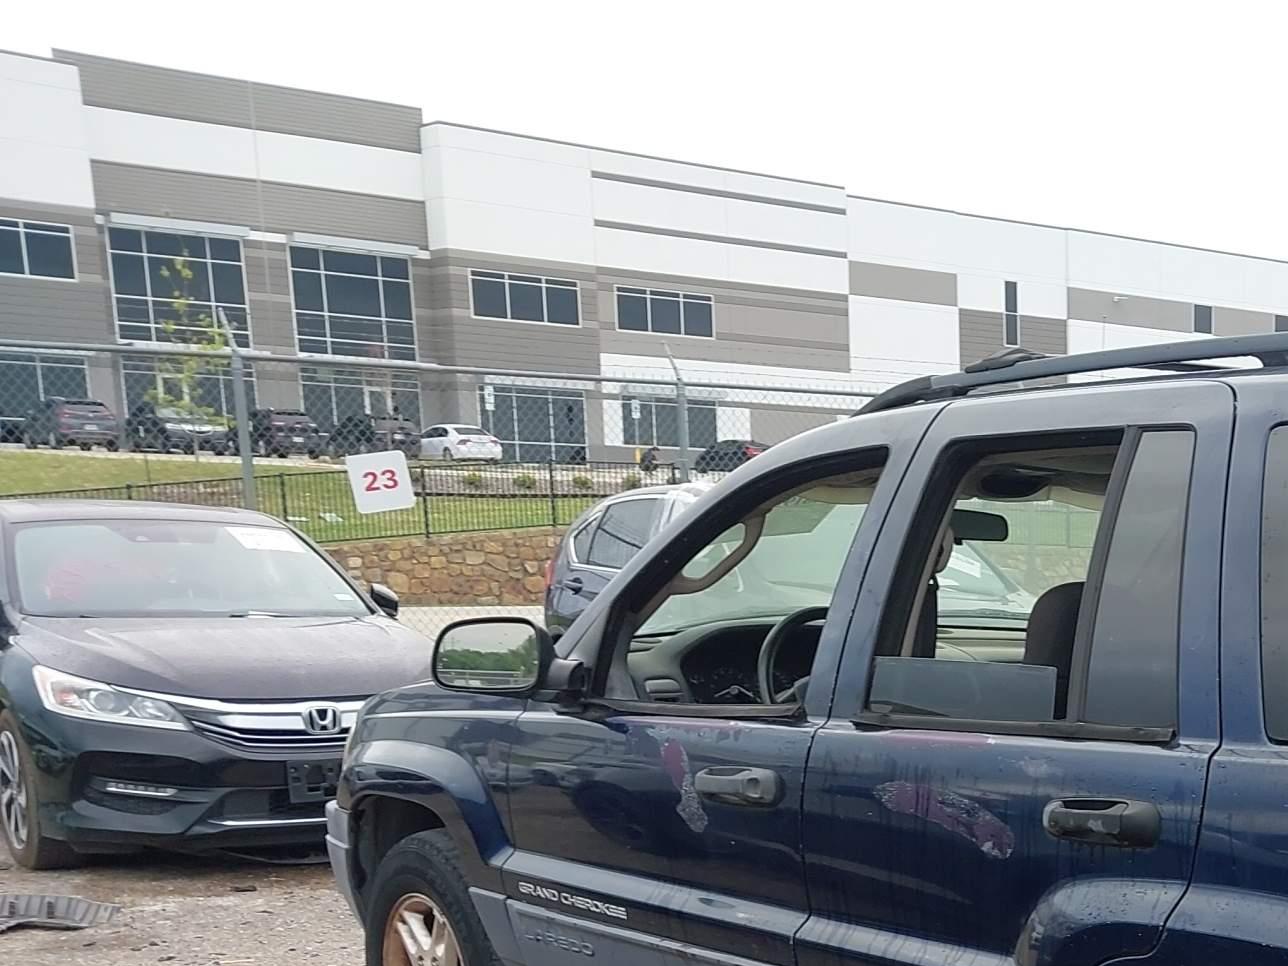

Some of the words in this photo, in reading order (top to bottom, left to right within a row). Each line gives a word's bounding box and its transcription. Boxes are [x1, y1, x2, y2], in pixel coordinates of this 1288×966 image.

[363, 469, 398, 492] 23
[518, 881, 559, 901] GRAND
[560, 892, 628, 920] CHEROKEE
